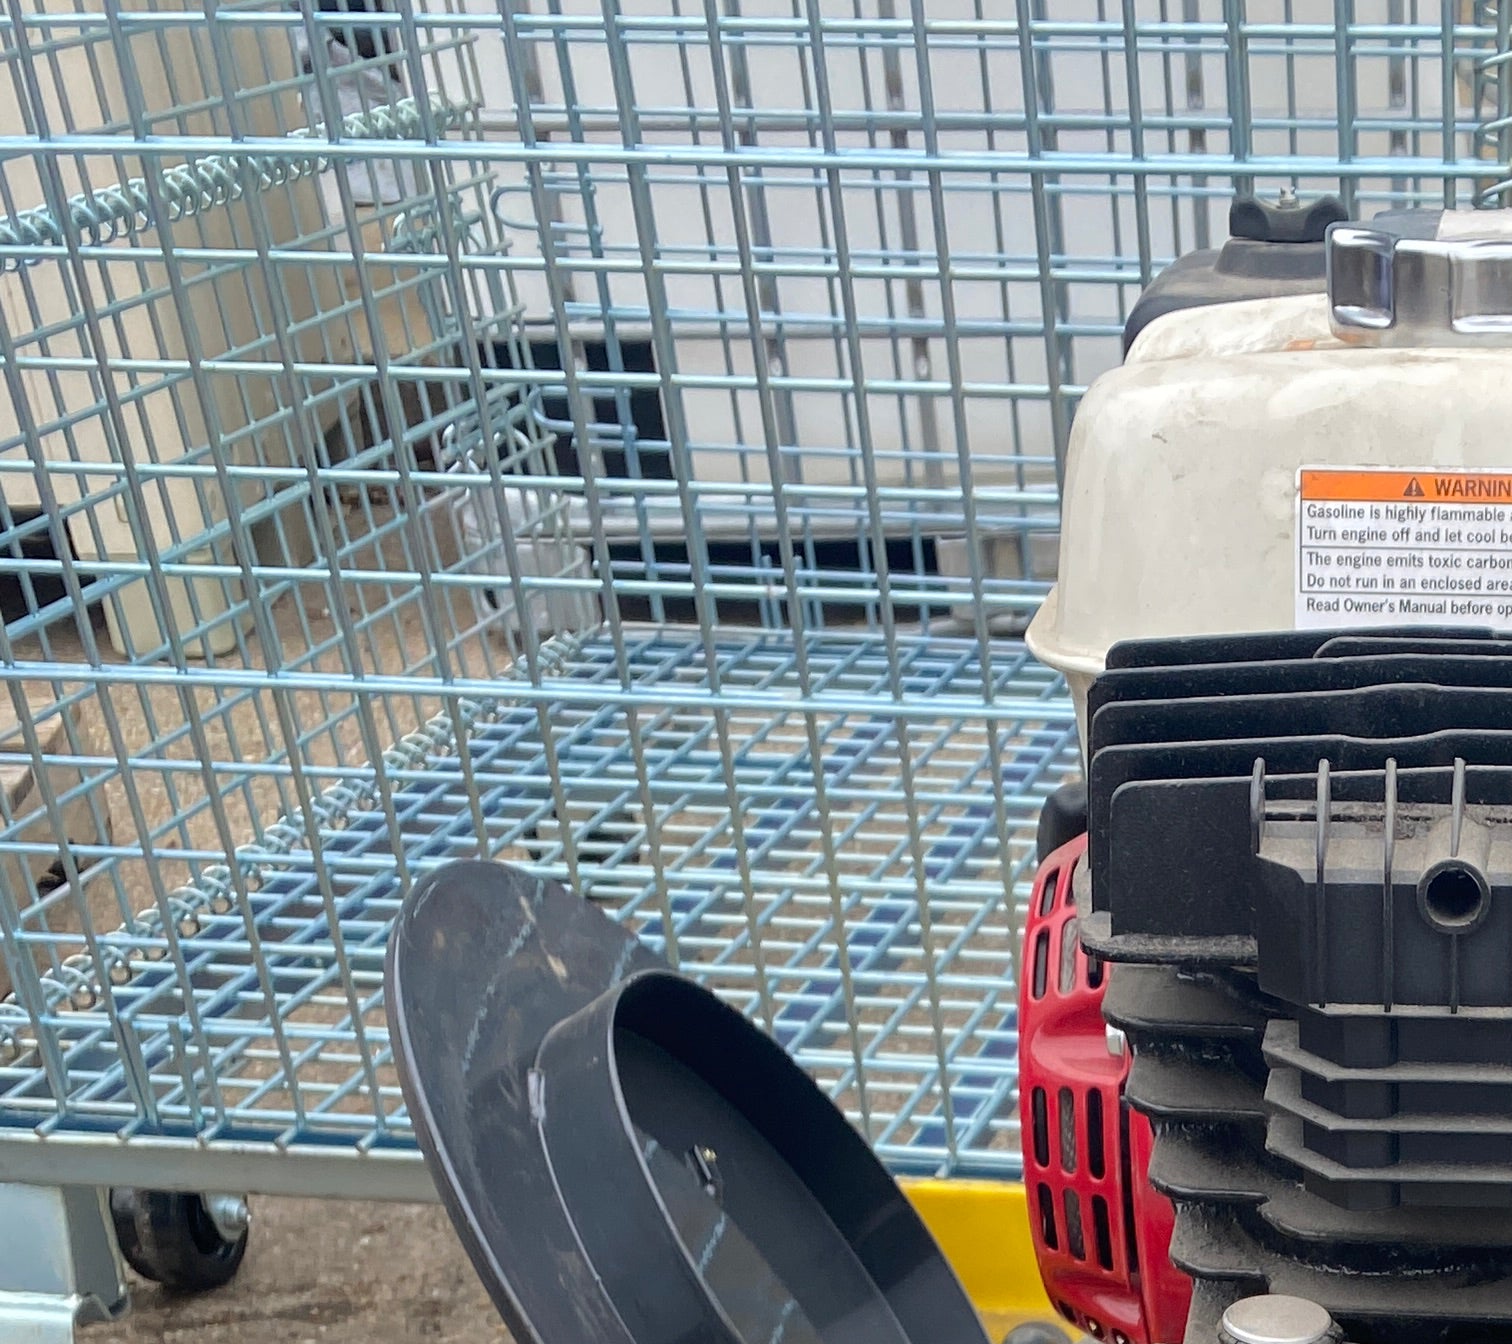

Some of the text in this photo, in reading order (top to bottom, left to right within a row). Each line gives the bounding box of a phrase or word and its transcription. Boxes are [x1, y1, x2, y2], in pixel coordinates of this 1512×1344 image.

[1306, 503, 1365, 519] Gasoline
[1369, 504, 1381, 520] is
[1385, 504, 1427, 523] highly
[1431, 506, 1506, 522] flammable
[1306, 525, 1337, 541] Turn
[1341, 526, 1388, 544] engine
[1391, 527, 1411, 542] off
[1414, 528, 1441, 543] and
[1445, 528, 1463, 543] let
[1466, 529, 1496, 543] cool
[1306, 551, 1332, 566] The
[1336, 552, 1383, 569] engine
[1386, 553, 1424, 568] emits
[1428, 554, 1462, 568] toxic
[1306, 573, 1325, 588] Do
[1329, 574, 1351, 588] not
[1355, 576, 1378, 589] run
[1382, 574, 1395, 589] in
[1399, 577, 1416, 590] an
[1420, 576, 1482, 591] enclosed
[1306, 597, 1340, 613] Read
[1343, 598, 1395, 613] Owner's
[1399, 599, 1447, 614] Manual
[1450, 600, 1493, 615] before
